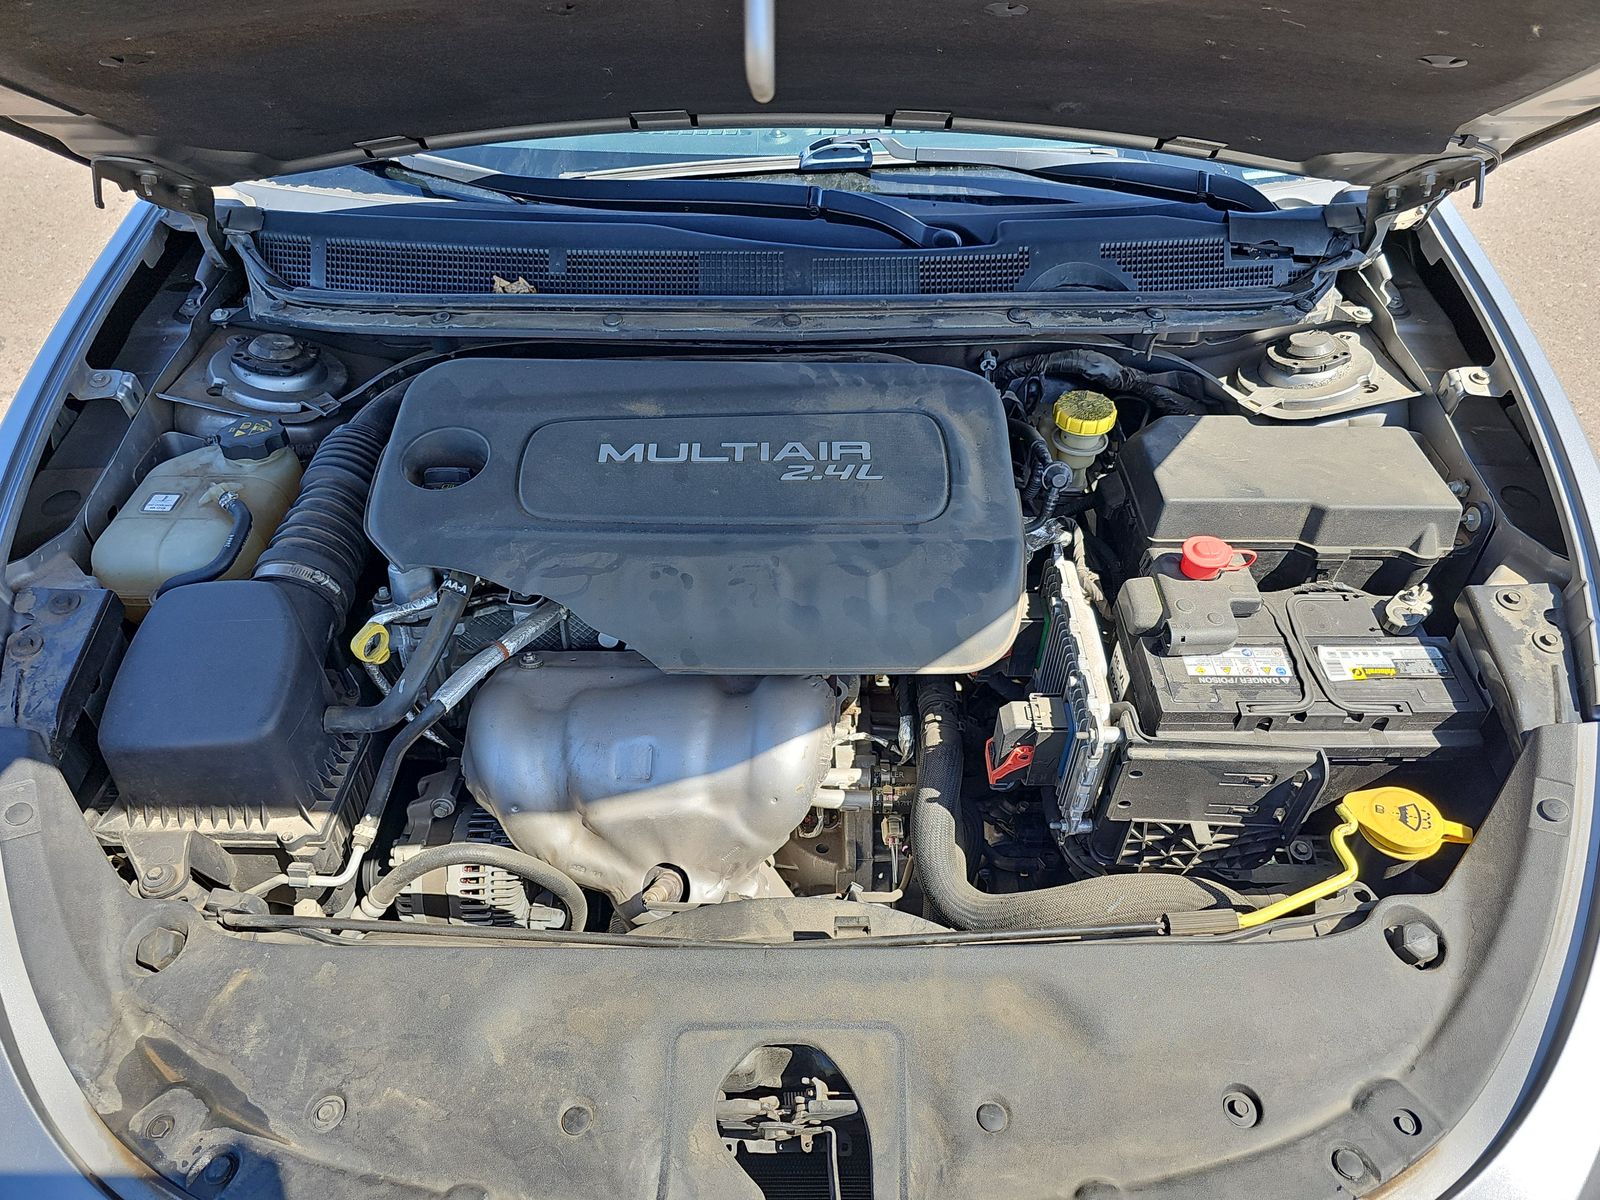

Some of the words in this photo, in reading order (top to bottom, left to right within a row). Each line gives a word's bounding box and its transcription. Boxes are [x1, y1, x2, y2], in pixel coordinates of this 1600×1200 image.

[598, 441, 872, 463] MULTIAIR
[779, 464, 884, 481] 2.4L
[1198, 676, 1234, 684] POISON
[1239, 676, 1280, 684] DANGER
